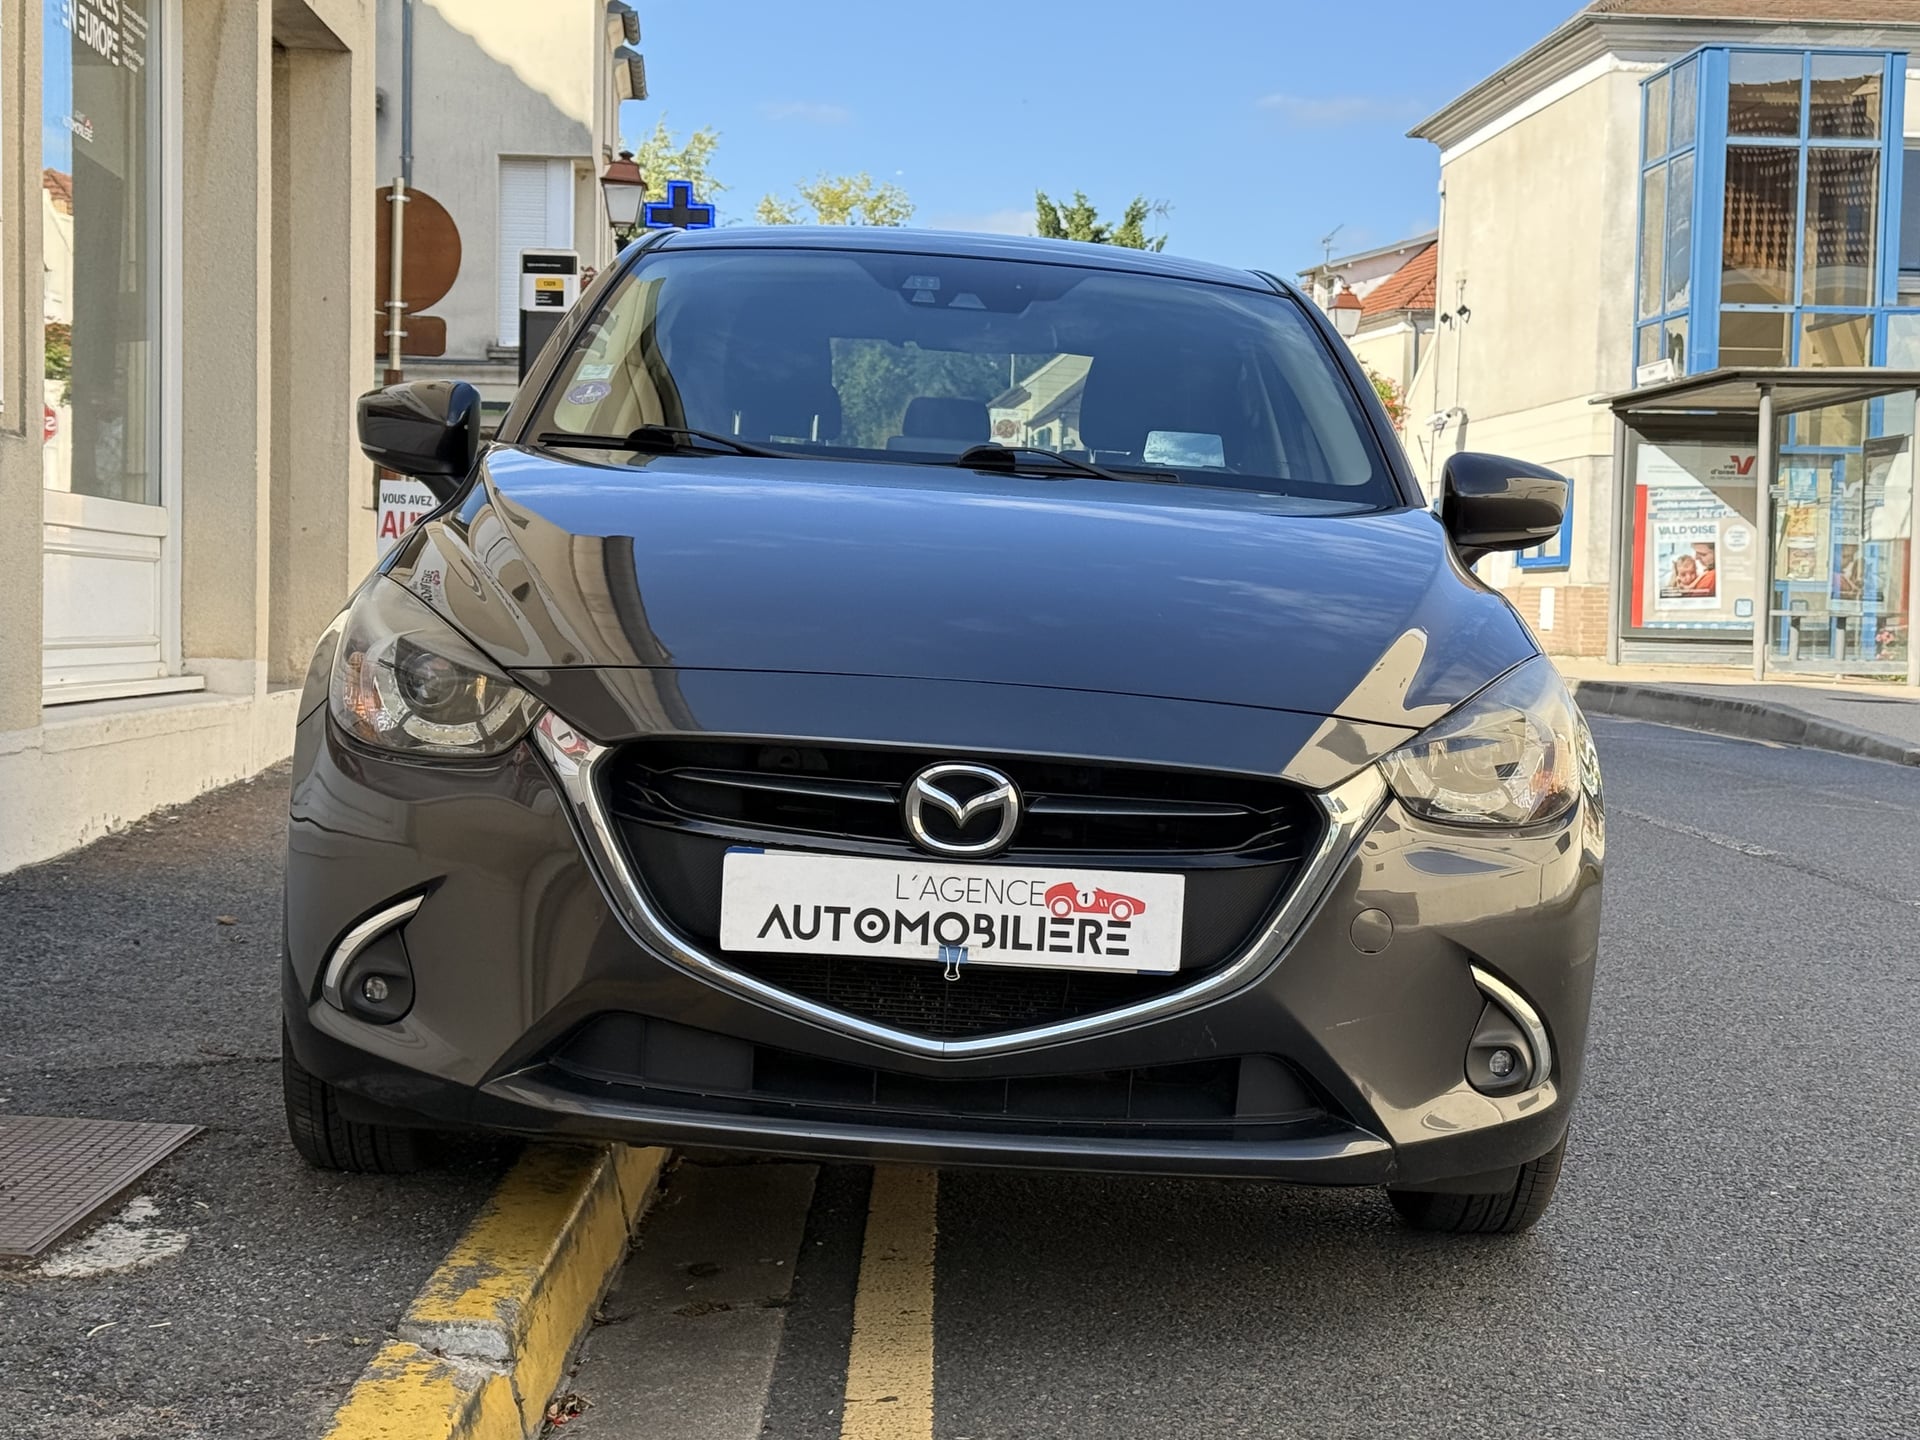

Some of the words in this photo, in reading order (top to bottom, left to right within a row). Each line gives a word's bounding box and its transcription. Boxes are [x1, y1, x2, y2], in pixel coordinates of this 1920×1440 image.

[78, 4, 119, 66] EUROPE
[382, 493, 407, 505] VOUS
[408, 494, 433, 507] AVEZ
[896, 873, 1046, 907] L'AGENCE
[1082, 892, 1088, 904] 1
[756, 903, 1132, 956] AUTOMOBILIERE
